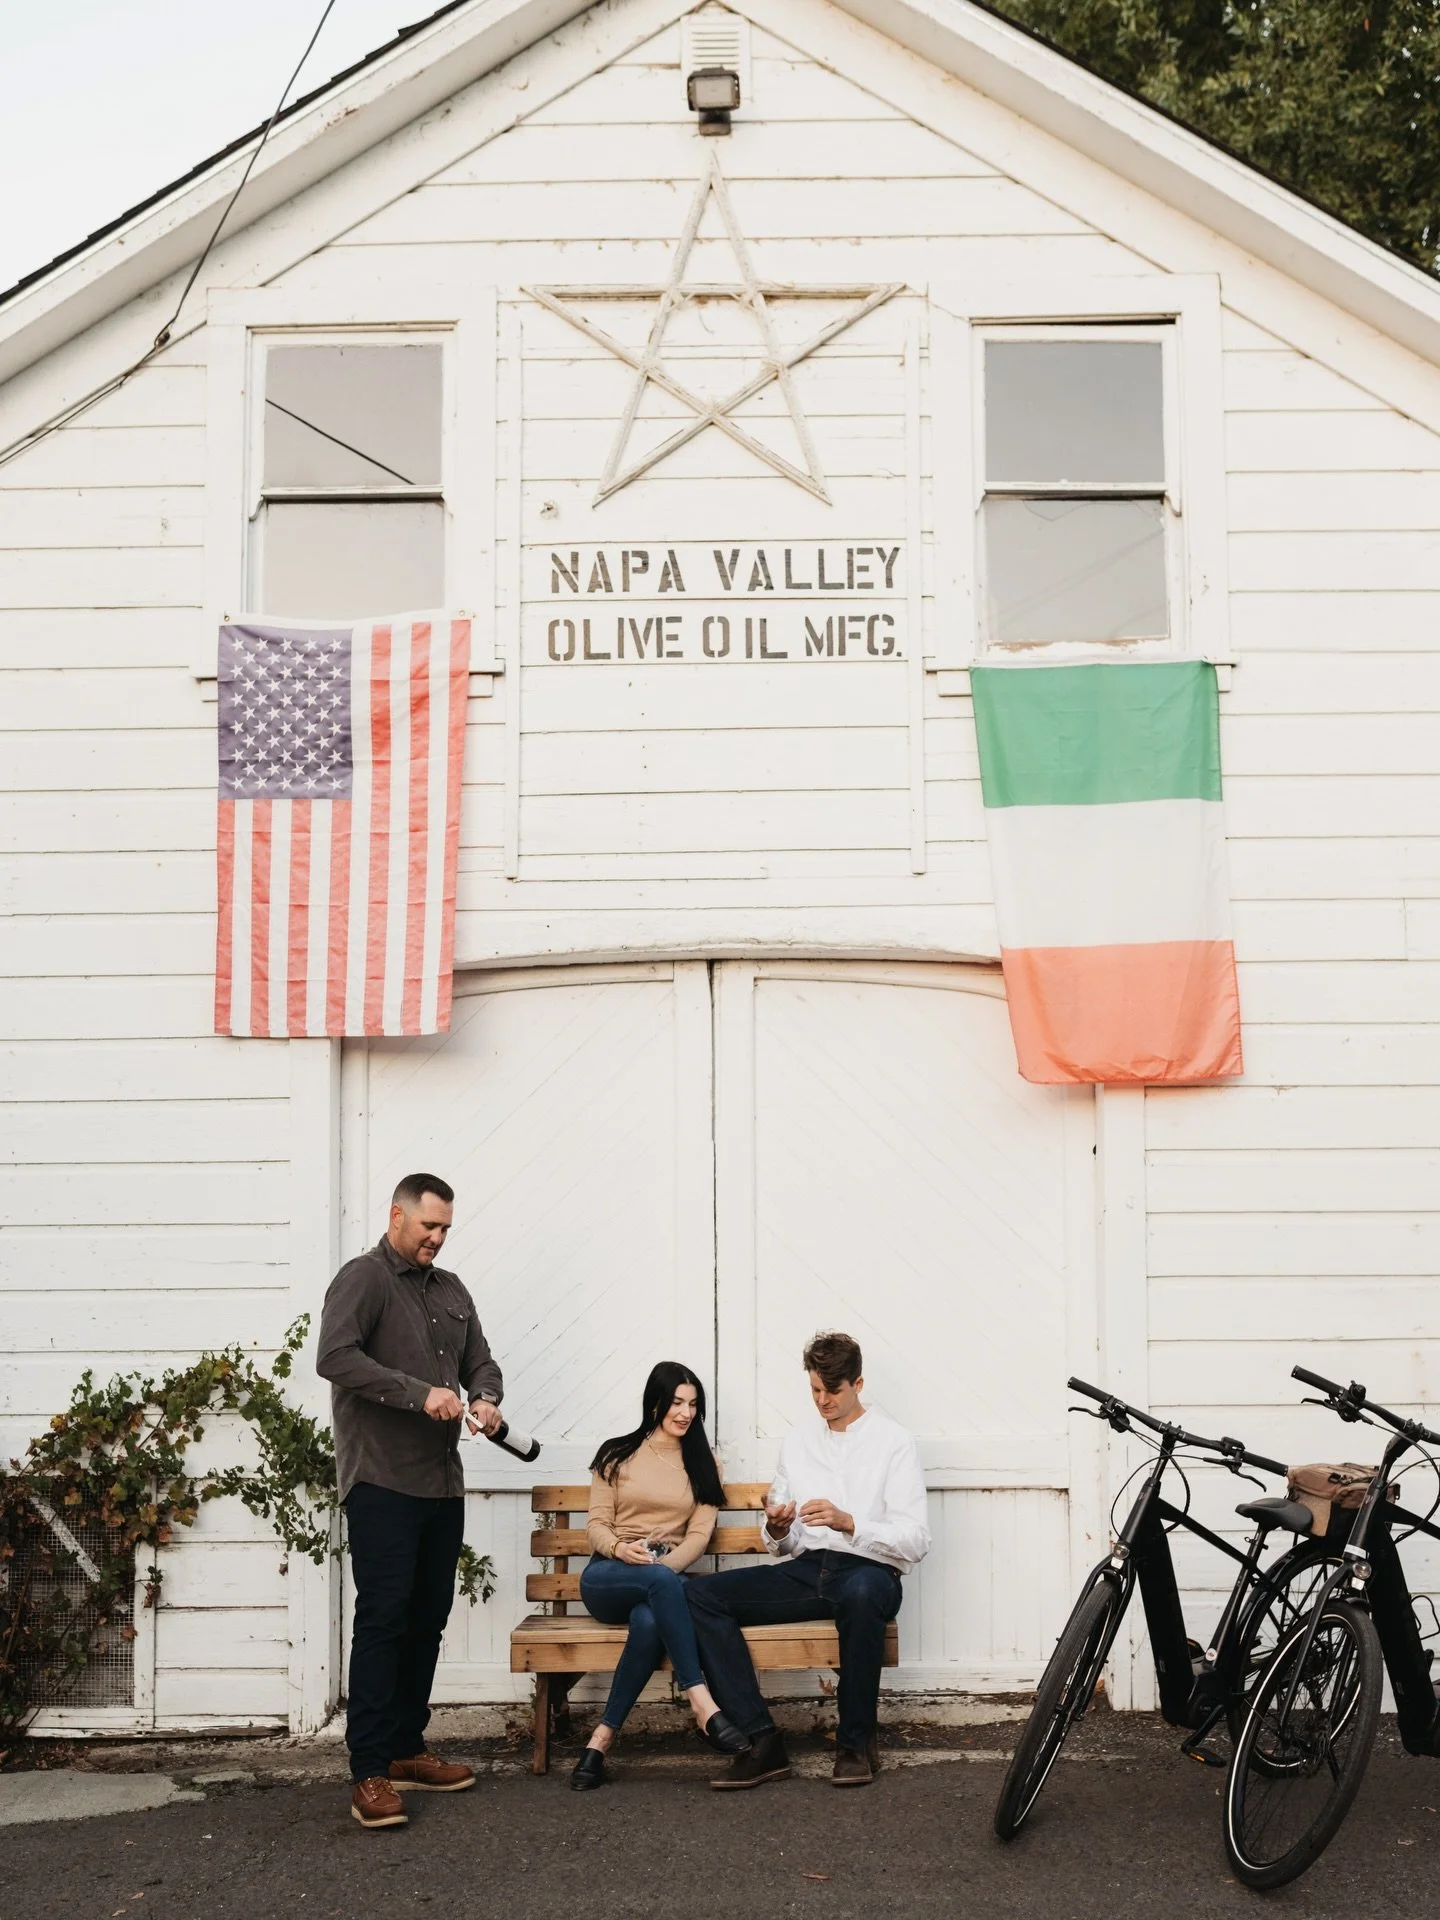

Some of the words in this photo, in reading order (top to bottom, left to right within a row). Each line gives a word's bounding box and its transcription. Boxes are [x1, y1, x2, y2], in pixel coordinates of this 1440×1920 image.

[551, 550, 686, 593] NAPA
[713, 547, 901, 591] VALLEY
[548, 616, 683, 661] OLIVE
[702, 615, 788, 659] OIL
[804, 614, 903, 657] MFG.
